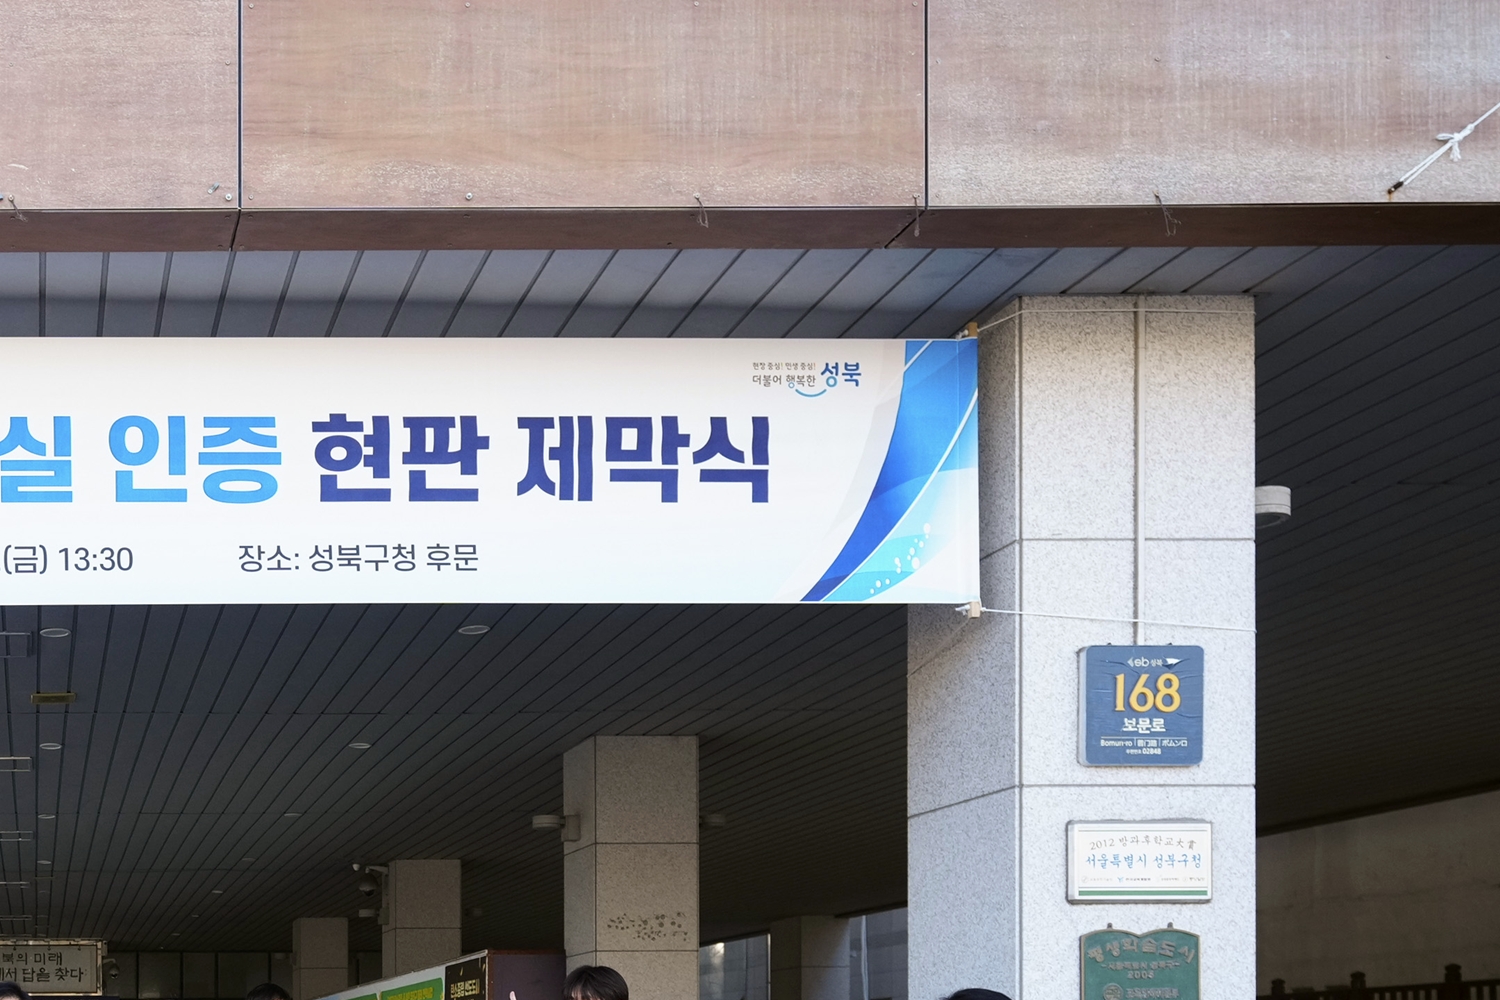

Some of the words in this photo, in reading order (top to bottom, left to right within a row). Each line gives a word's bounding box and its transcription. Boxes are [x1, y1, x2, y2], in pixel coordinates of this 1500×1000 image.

[752, 362, 766, 370] 현장
[768, 362, 783, 370] 중심!
[800, 362, 816, 370] 중심!
[752, 375, 782, 387] 더불어
[786, 374, 816, 388] 행복한
[820, 362, 862, 388] 성북
[109, 416, 281, 503] 인증
[312, 413, 490, 502] 현판
[517, 416, 769, 503] 제막식
[59, 547, 133, 572] 13:30
[239, 545, 299, 572] 장소:
[309, 544, 416, 572] 성북구청
[427, 544, 478, 572] 후문
[1115, 672, 1181, 712] 168
[1122, 718, 1166, 734] 보문로
[1090, 838, 1114, 850] 2012
[1086, 854, 1148, 869] 서울특별시
[1153, 854, 1201, 869] 성북구청
[34, 952, 62, 965] 미래
[1087, 938, 1195, 964] 평생학습도시
[22, 968, 50, 982] 답을
[55, 968, 84, 982] 찾다
